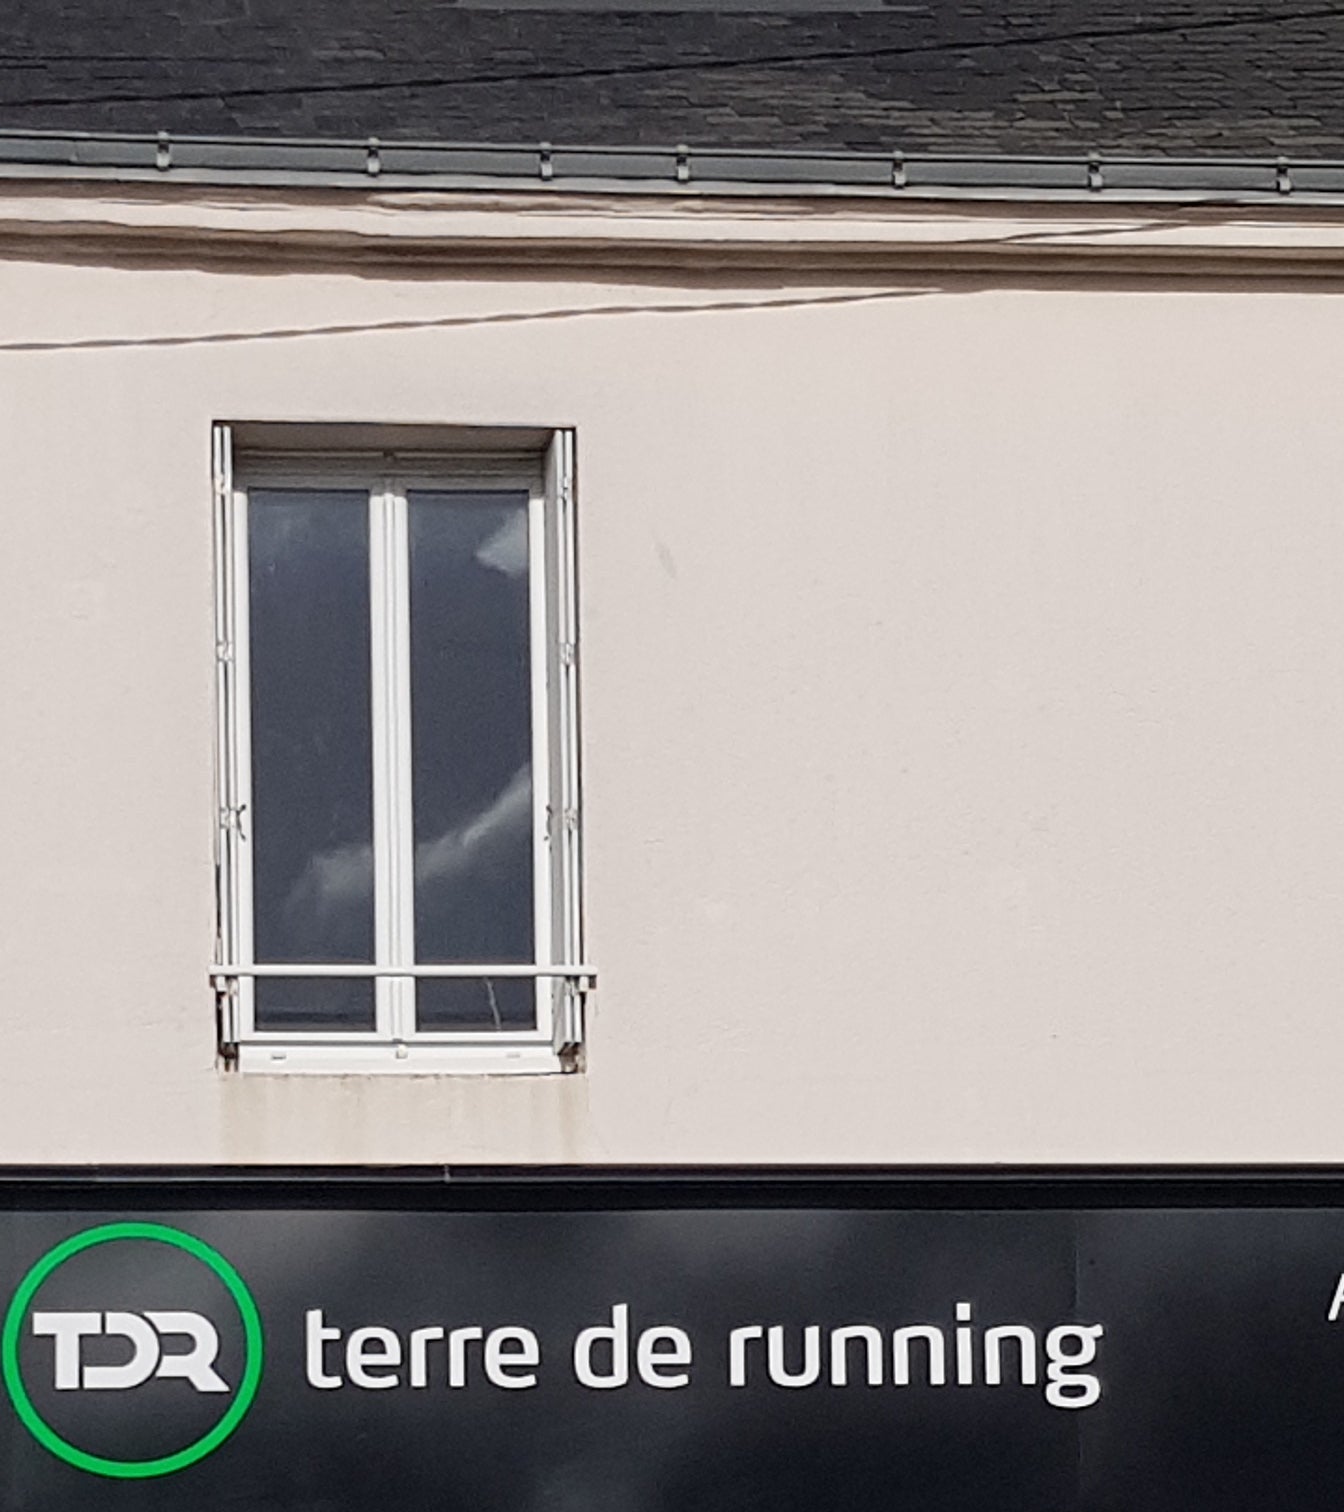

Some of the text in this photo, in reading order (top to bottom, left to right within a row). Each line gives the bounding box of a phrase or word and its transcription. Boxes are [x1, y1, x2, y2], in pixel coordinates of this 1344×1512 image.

[32, 1302, 1104, 1409] TDR terre de running
